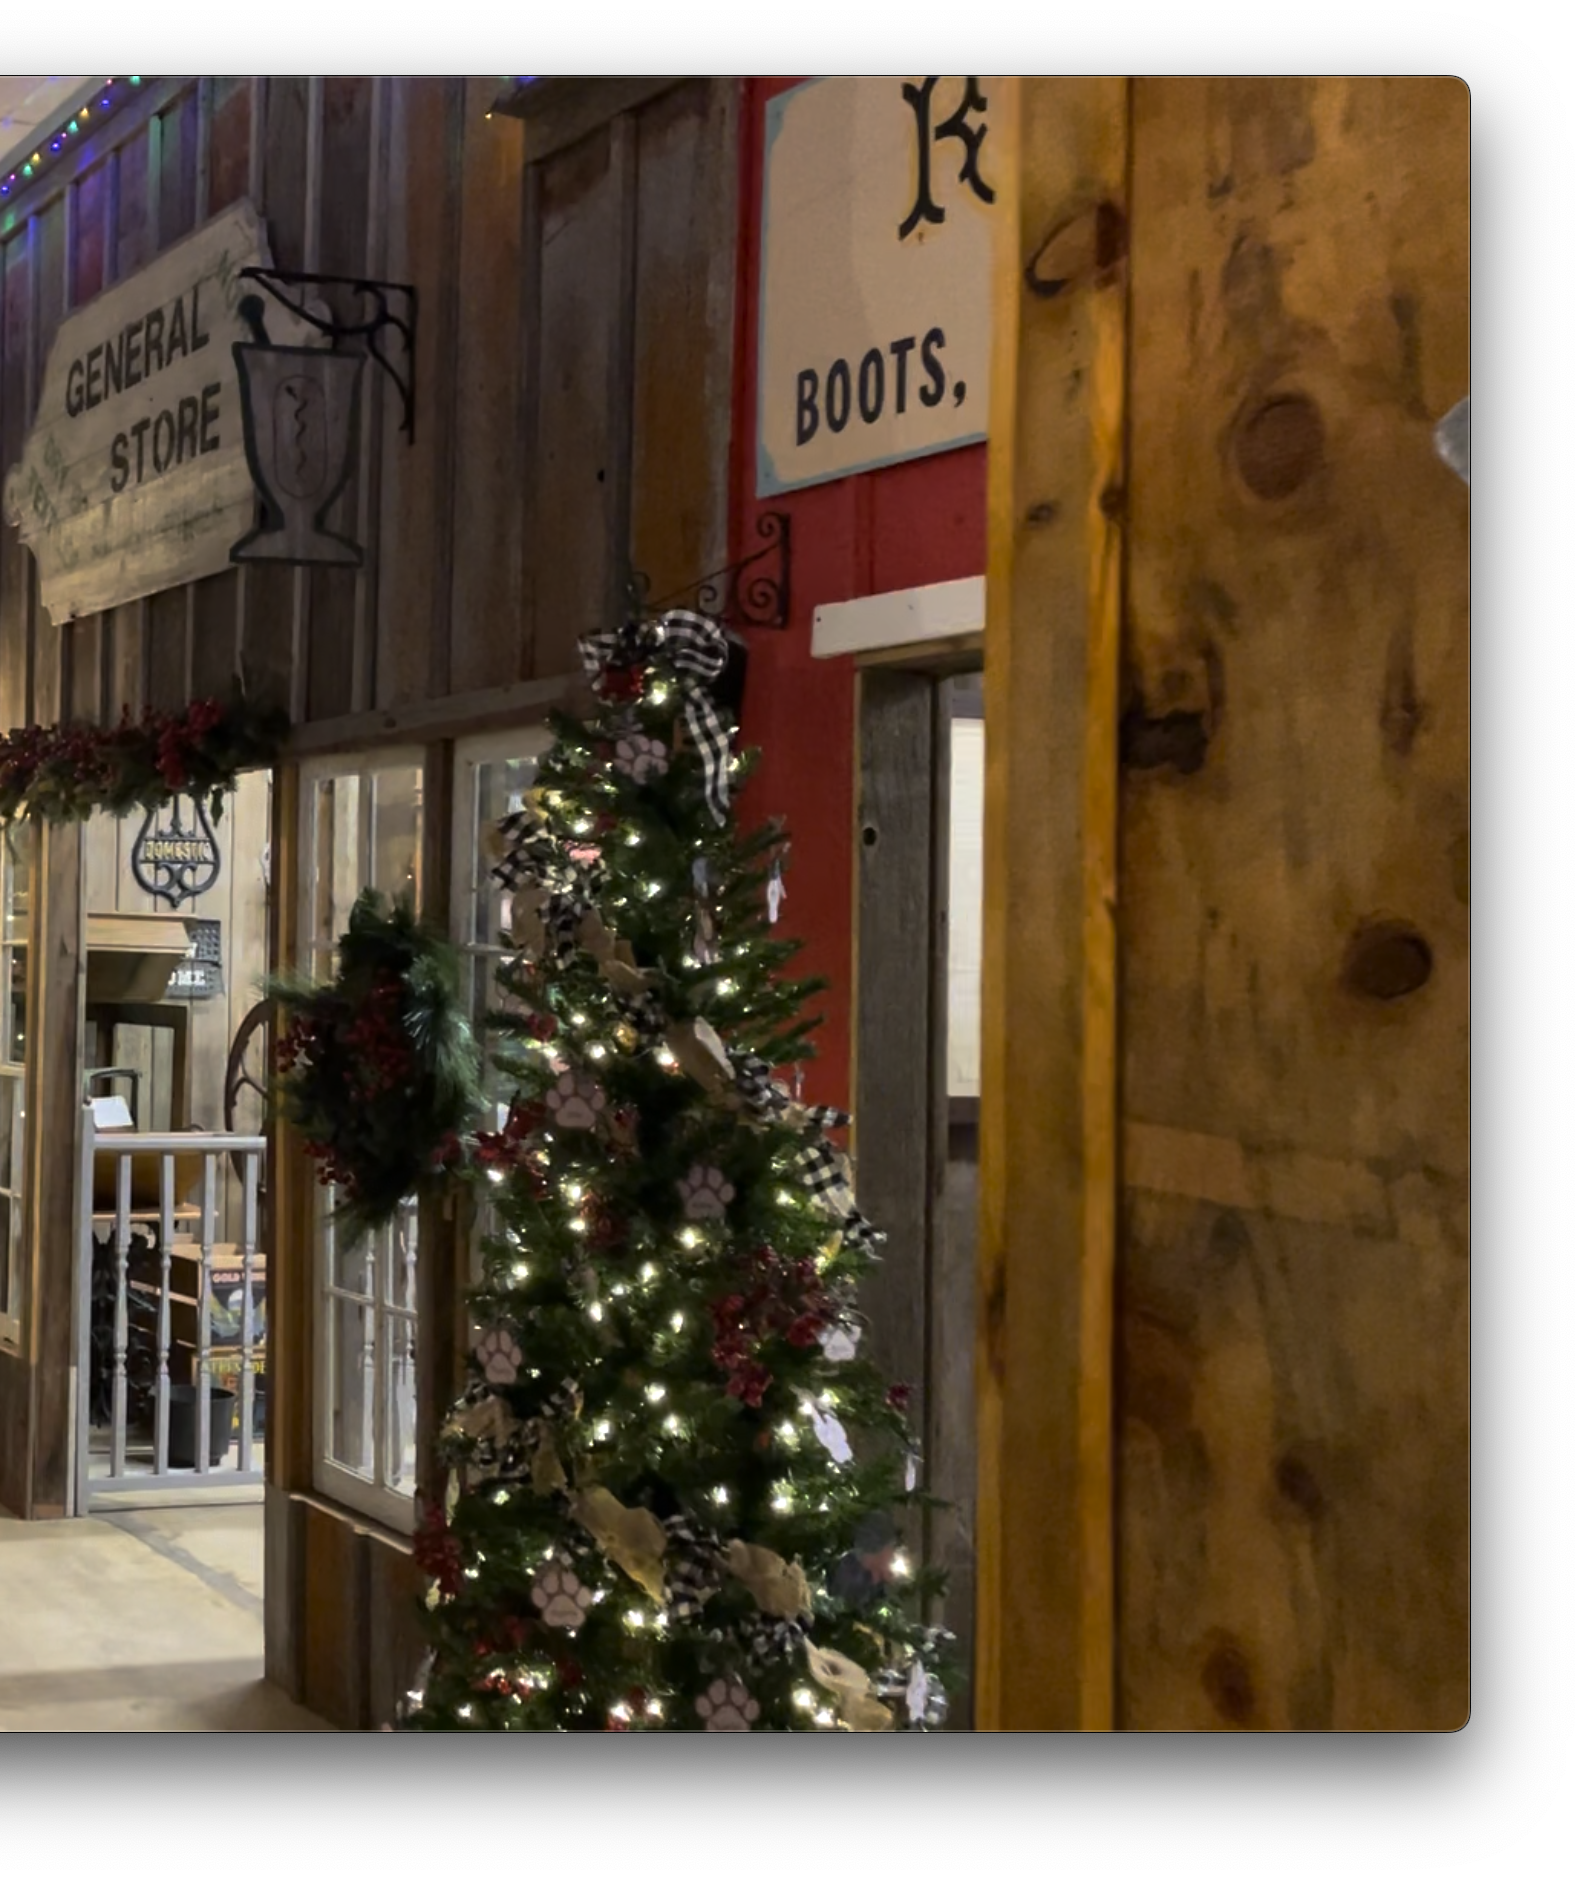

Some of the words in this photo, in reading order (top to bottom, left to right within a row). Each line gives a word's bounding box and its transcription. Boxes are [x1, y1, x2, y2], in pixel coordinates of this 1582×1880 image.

[66, 284, 210, 418] GENERAL
[796, 327, 967, 447] BOOTS,
[111, 382, 221, 493] STORE
[144, 840, 211, 861] DOMESTIC
[212, 1272, 240, 1283] GOLD
